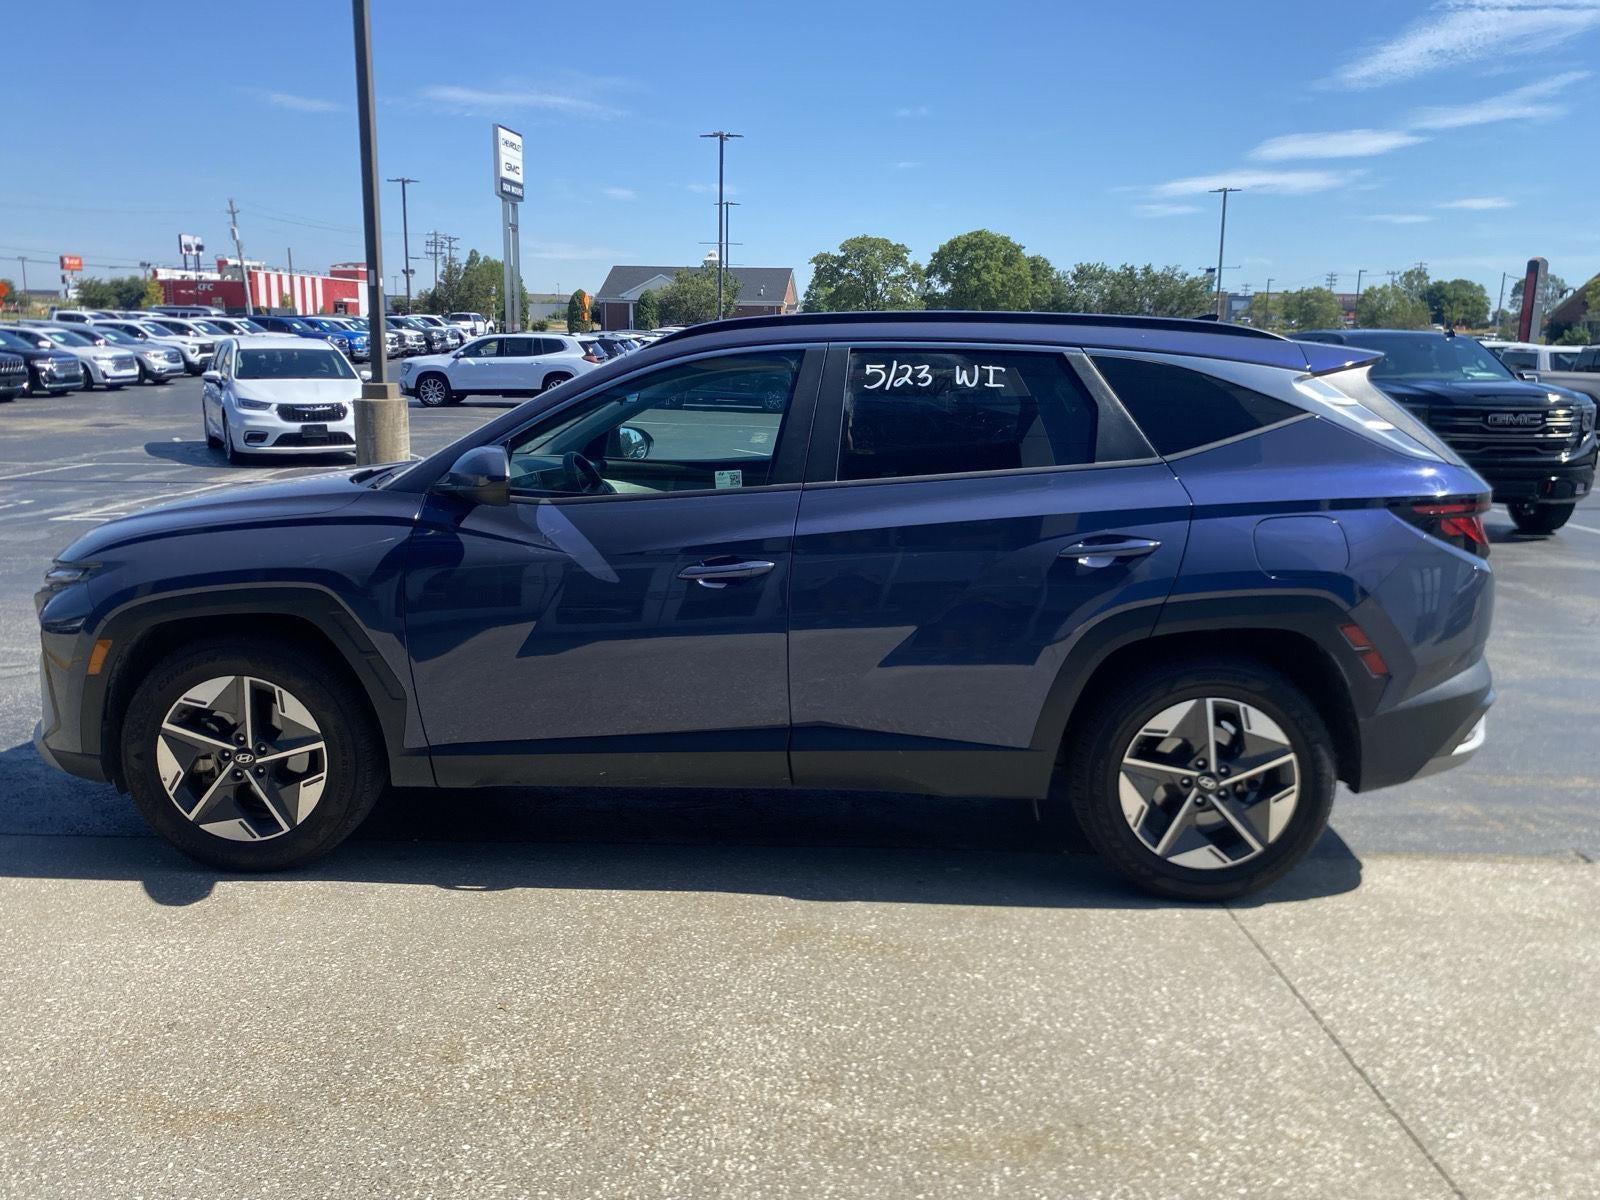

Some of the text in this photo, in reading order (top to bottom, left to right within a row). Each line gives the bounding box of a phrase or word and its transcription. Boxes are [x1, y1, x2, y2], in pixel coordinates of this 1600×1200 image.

[505, 162, 520, 176] GMC
[863, 360, 1006, 390] 5/23 WI
[1487, 413, 1542, 426] GMC
